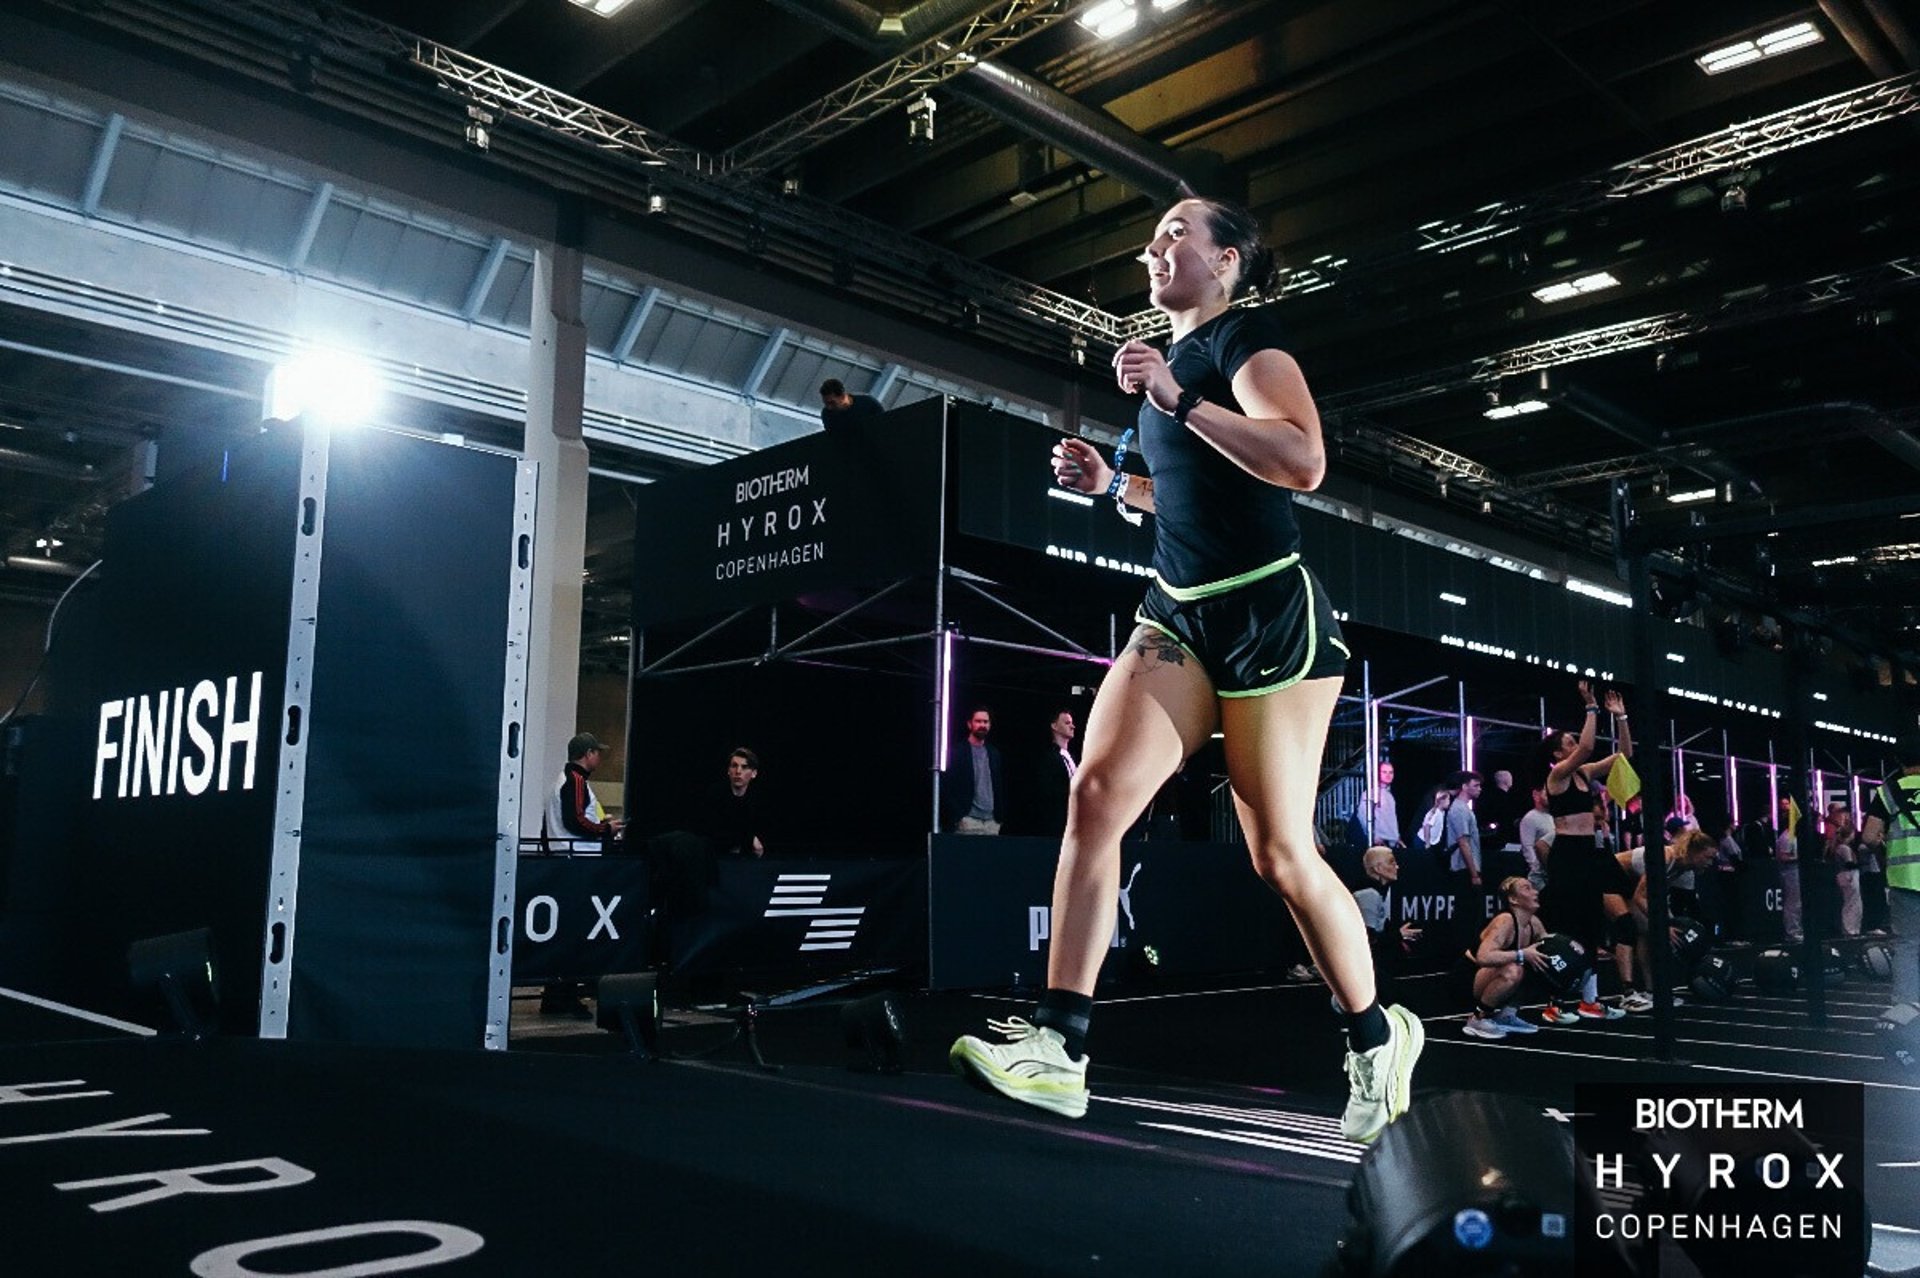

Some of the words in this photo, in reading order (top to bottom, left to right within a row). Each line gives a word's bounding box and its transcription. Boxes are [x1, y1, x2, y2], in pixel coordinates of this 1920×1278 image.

[736, 465, 809, 503] BIOTHERM
[717, 497, 826, 548] HYROX
[716, 541, 823, 580] COPENHAGEN
[93, 671, 263, 800] FINISH
